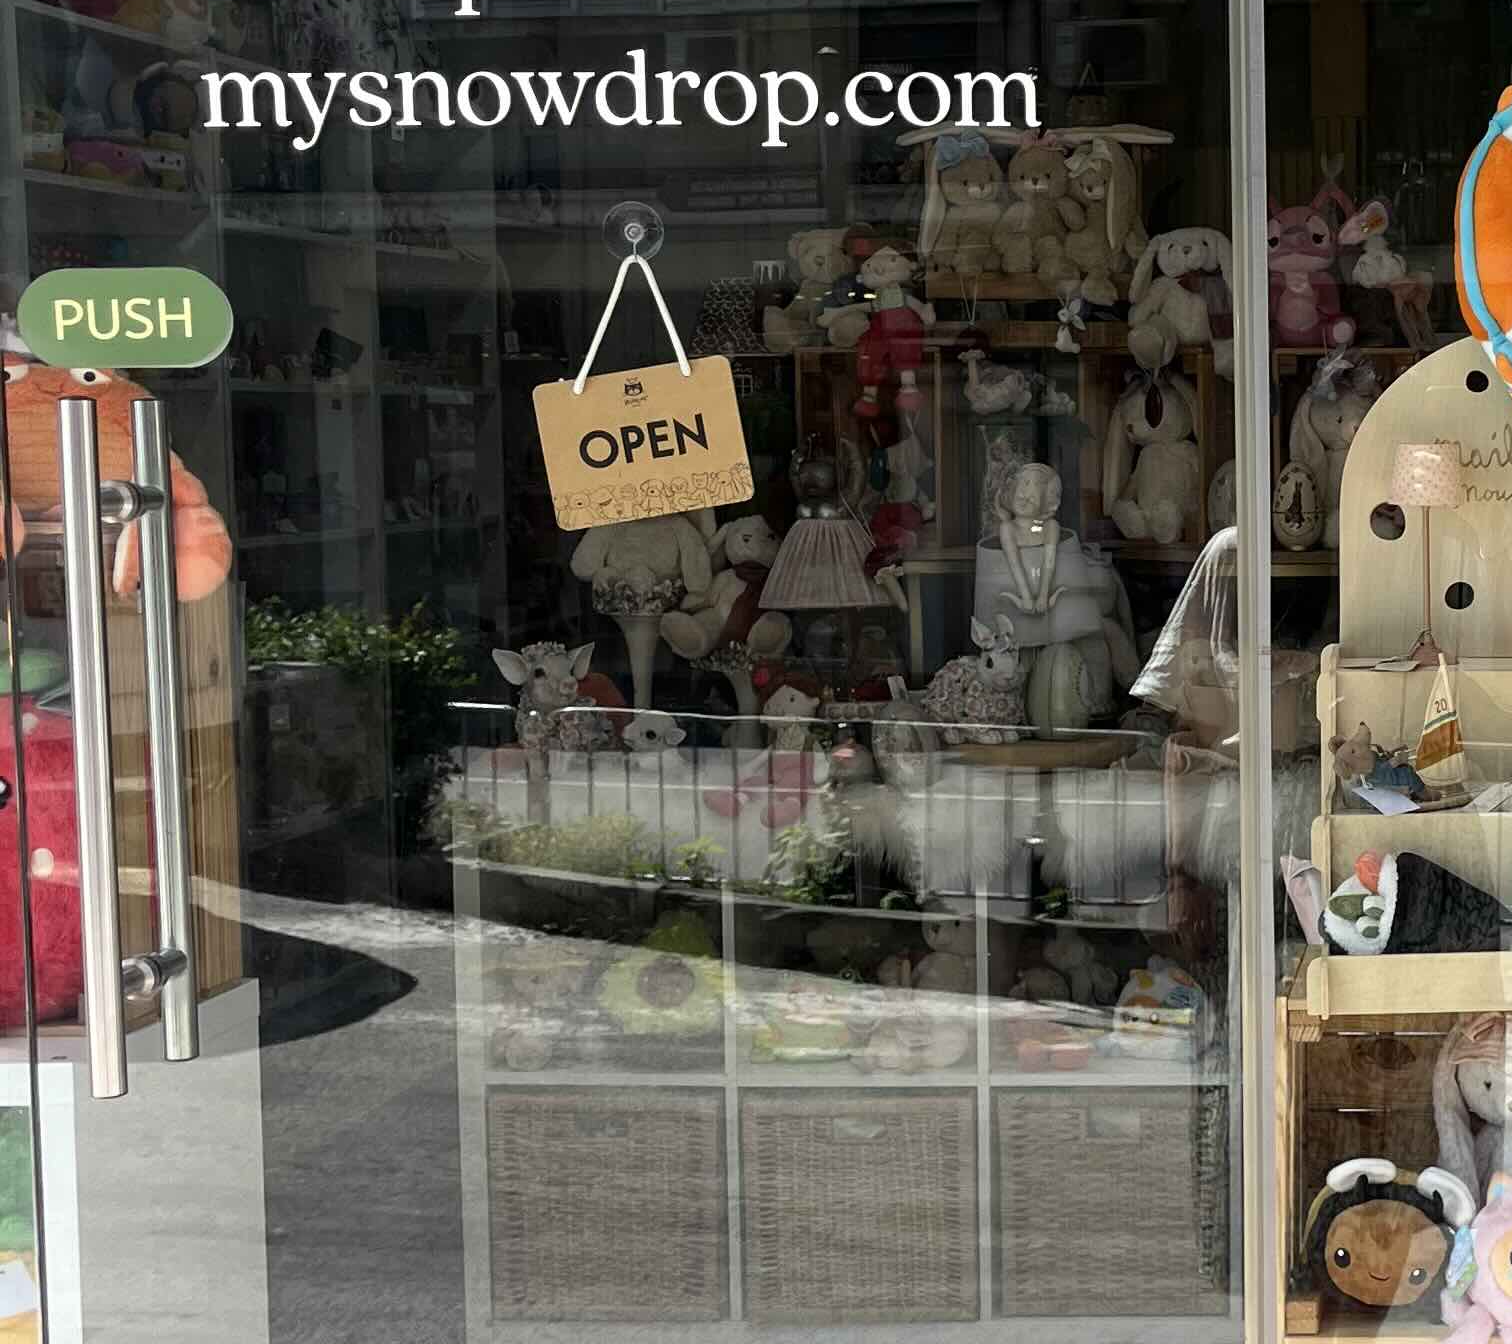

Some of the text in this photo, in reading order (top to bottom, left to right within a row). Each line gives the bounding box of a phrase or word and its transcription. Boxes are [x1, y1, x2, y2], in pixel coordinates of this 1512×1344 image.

[200, 48, 1043, 151] mysnowdrop.com
[53, 296, 193, 341] PUSH
[579, 413, 709, 469] OPEN
